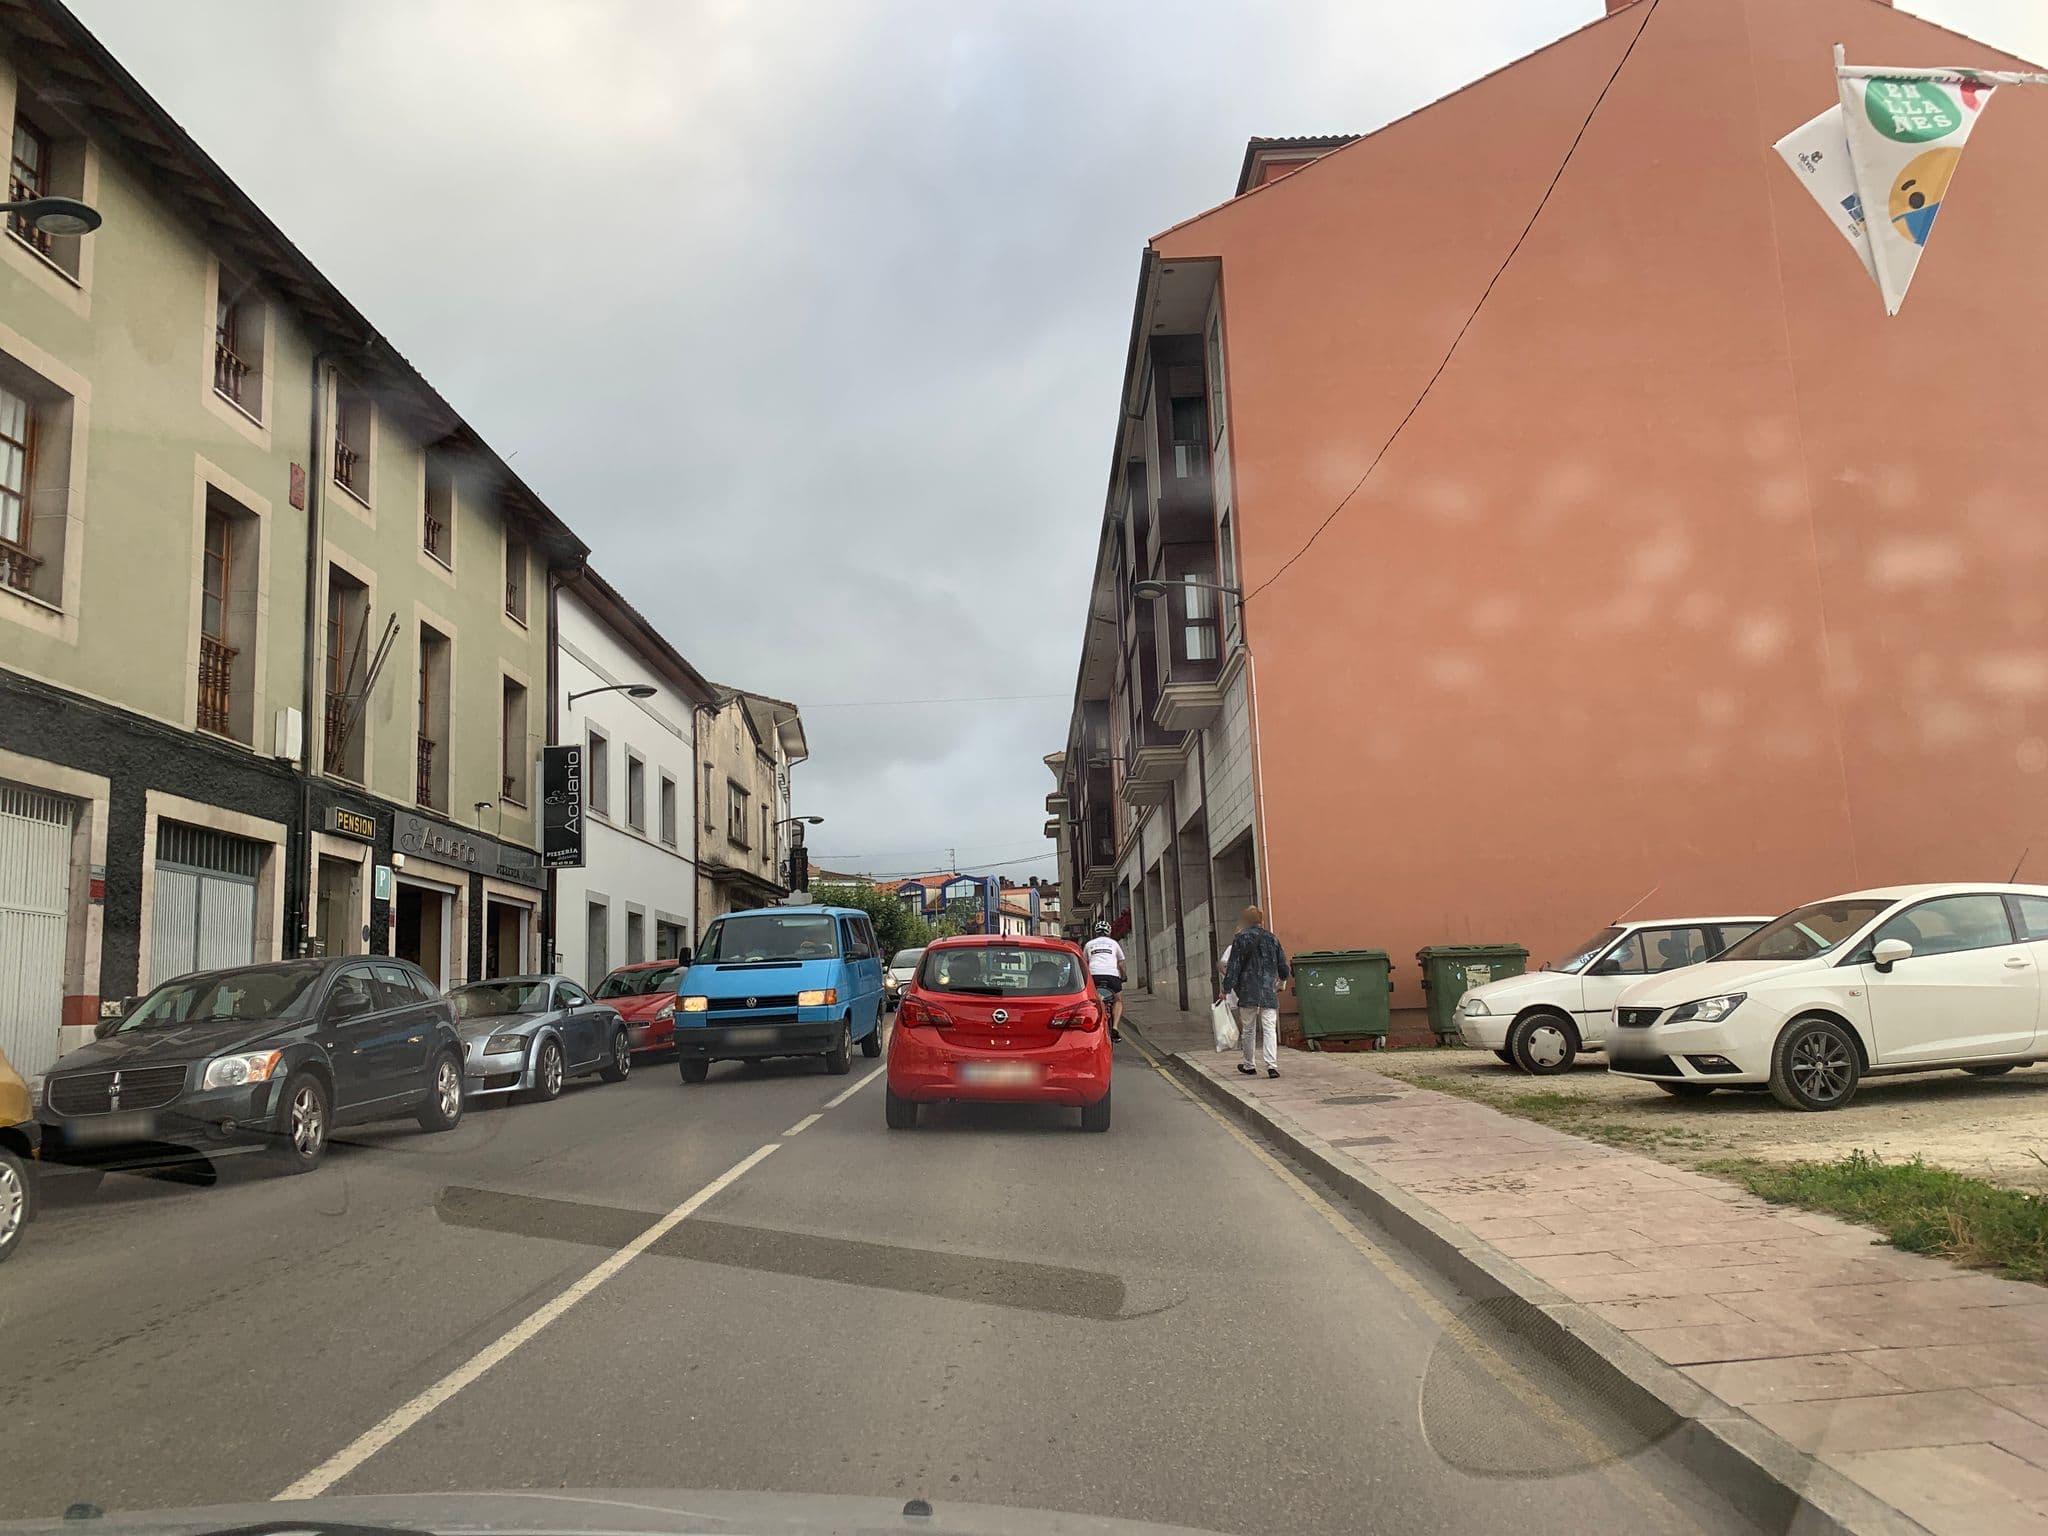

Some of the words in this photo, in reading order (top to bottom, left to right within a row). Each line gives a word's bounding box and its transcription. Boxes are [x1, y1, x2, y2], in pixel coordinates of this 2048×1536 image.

[1884, 99, 1943, 114] LLA
[1891, 115, 1953, 134] NES
[563, 751, 579, 834] Acuario
[337, 812, 373, 836] PENSION
[380, 870, 386, 887] P
